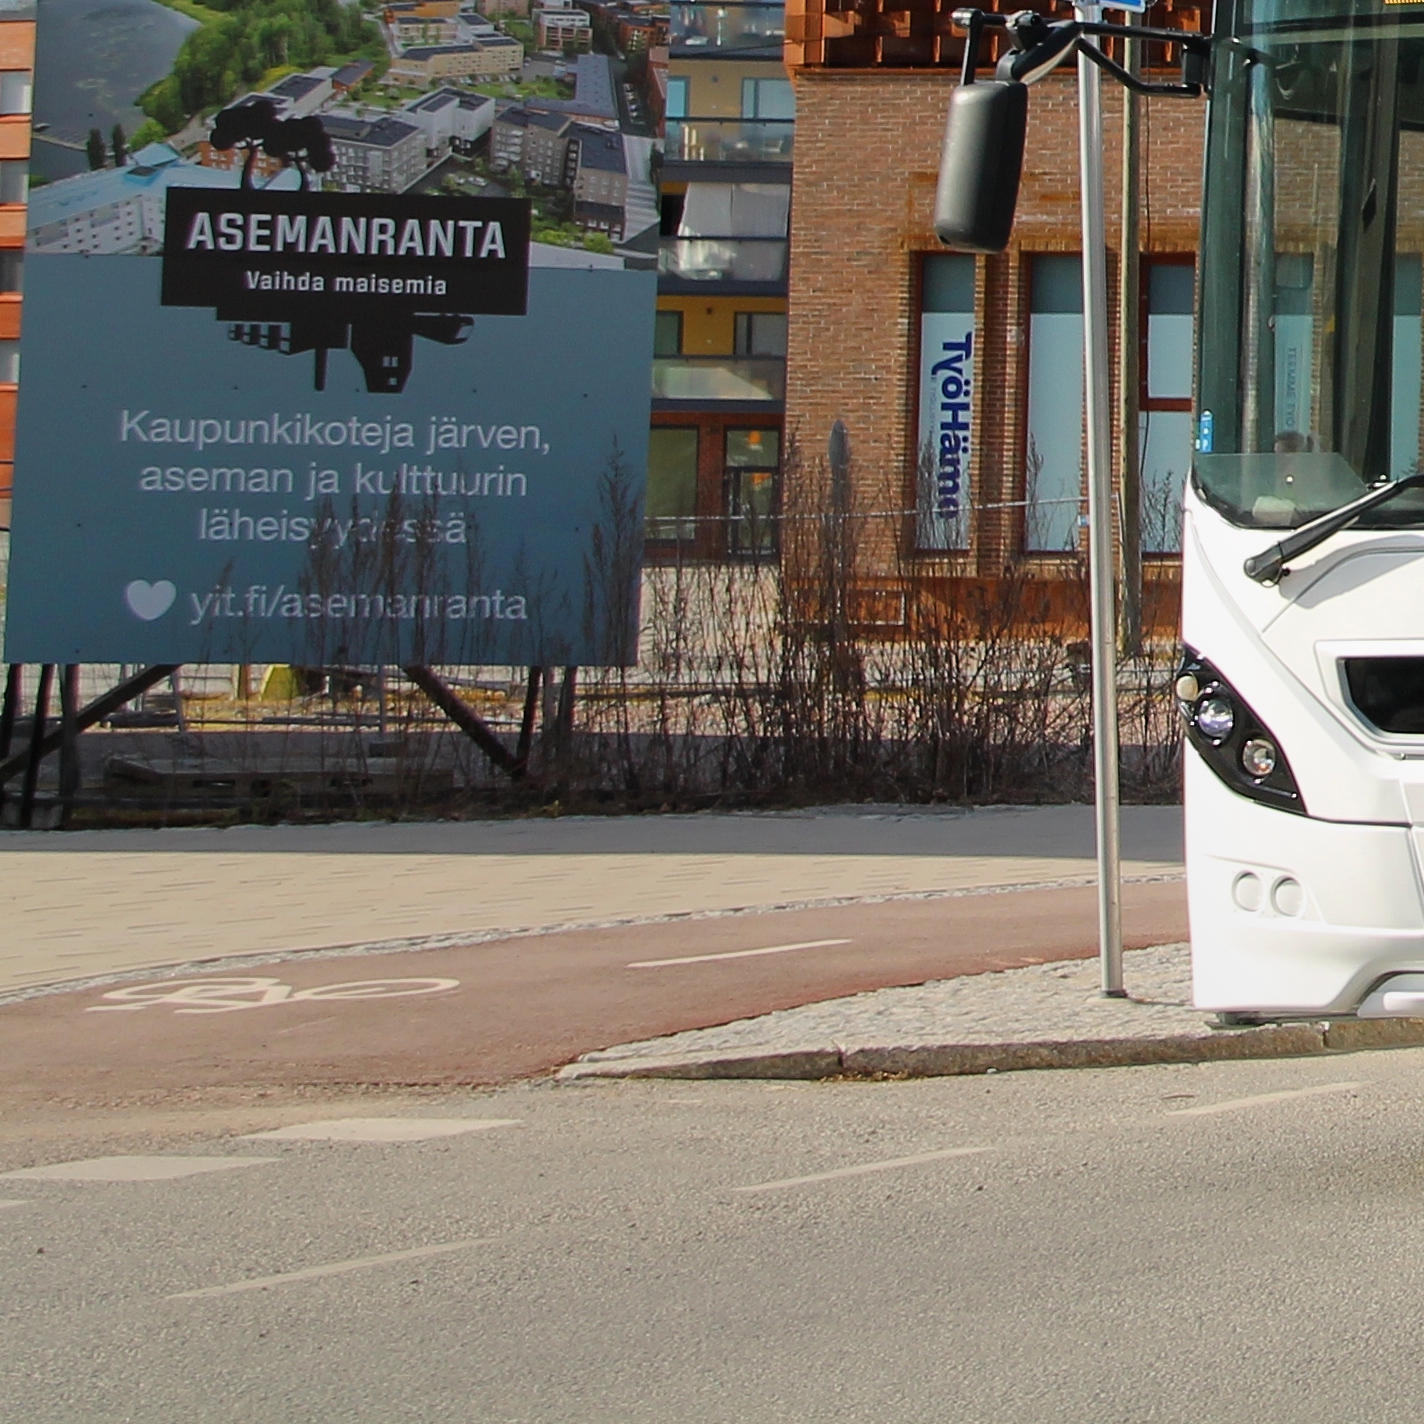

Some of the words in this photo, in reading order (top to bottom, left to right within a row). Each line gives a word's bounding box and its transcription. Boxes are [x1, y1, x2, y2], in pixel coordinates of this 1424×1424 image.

[186, 211, 506, 259] ASEMANRANTA
[246, 270, 325, 292] Vaihda
[334, 274, 447, 296] maisemia
[119, 409, 415, 455] Kaupunkikoteja
[425, 416, 551, 455] järven,
[139, 463, 294, 492] aseman
[305, 461, 340, 501] ja
[355, 462, 528, 497] kulttuurin
[189, 584, 528, 626] yit.fi/asemanranta
